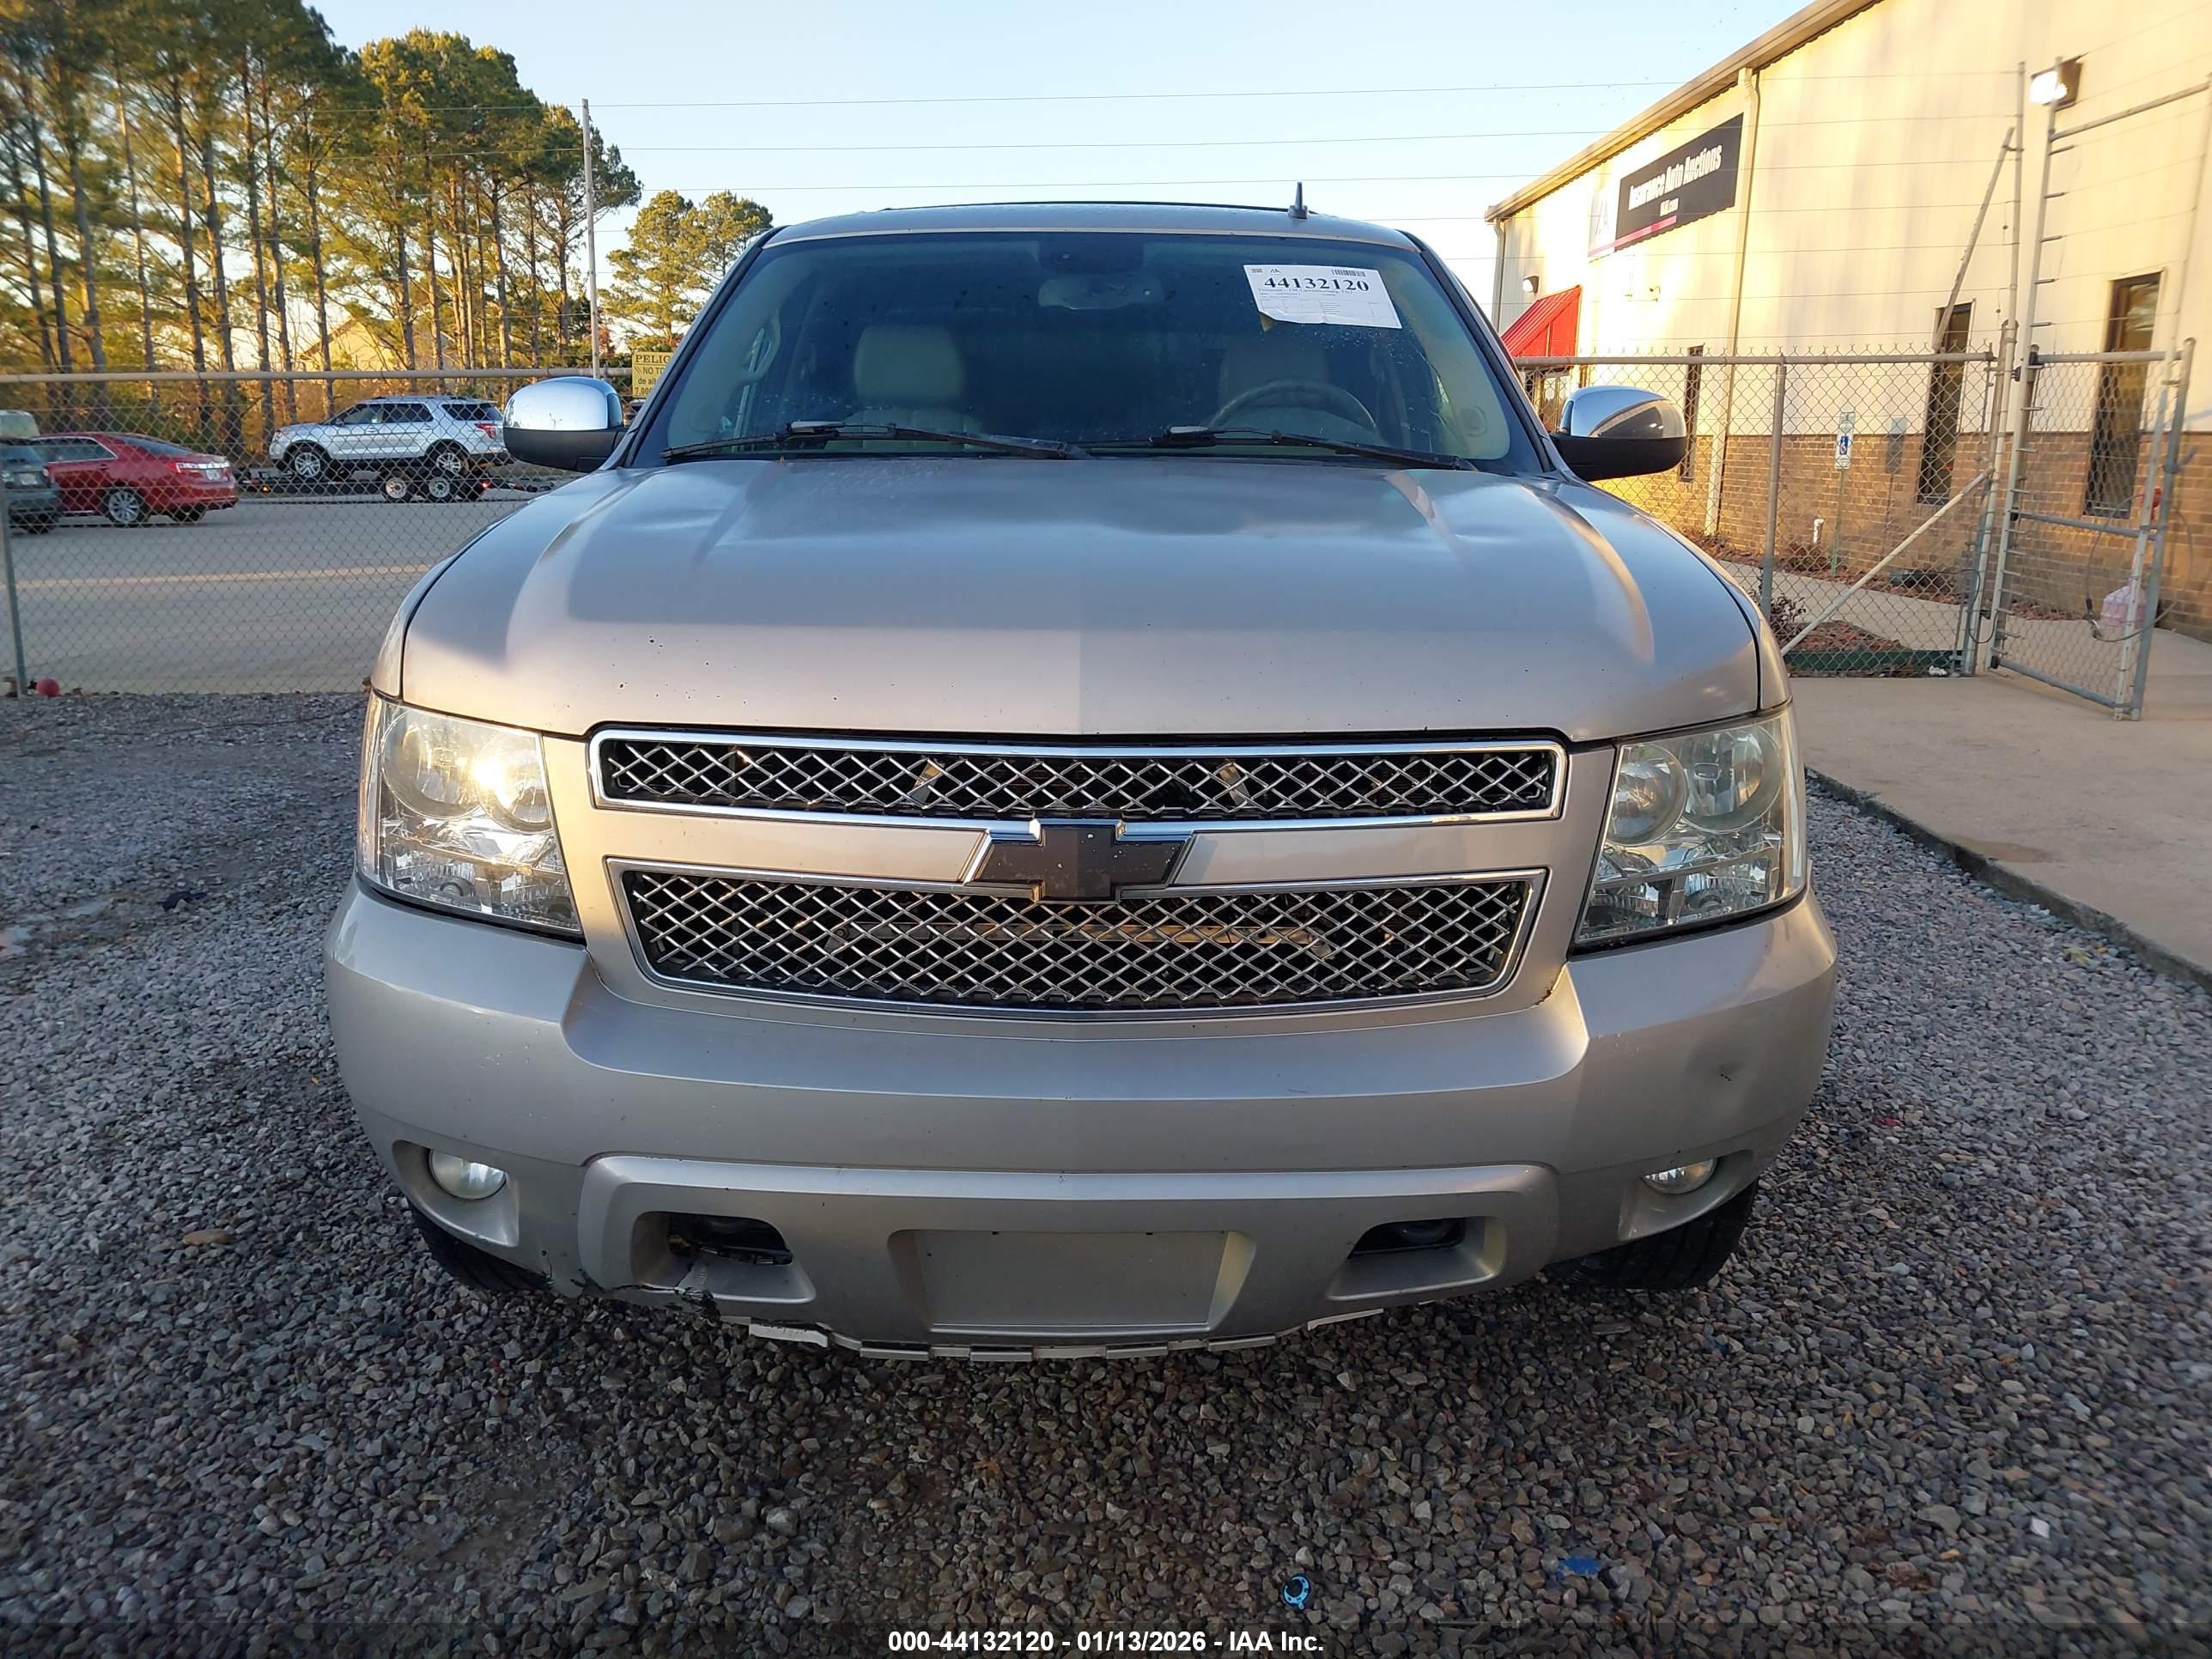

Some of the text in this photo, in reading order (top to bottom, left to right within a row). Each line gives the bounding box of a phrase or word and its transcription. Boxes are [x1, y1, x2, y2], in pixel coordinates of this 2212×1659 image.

[1666, 164, 1684, 194] Auto
[1682, 144, 1723, 185] Auctions
[1264, 276, 1369, 292] 44132120
